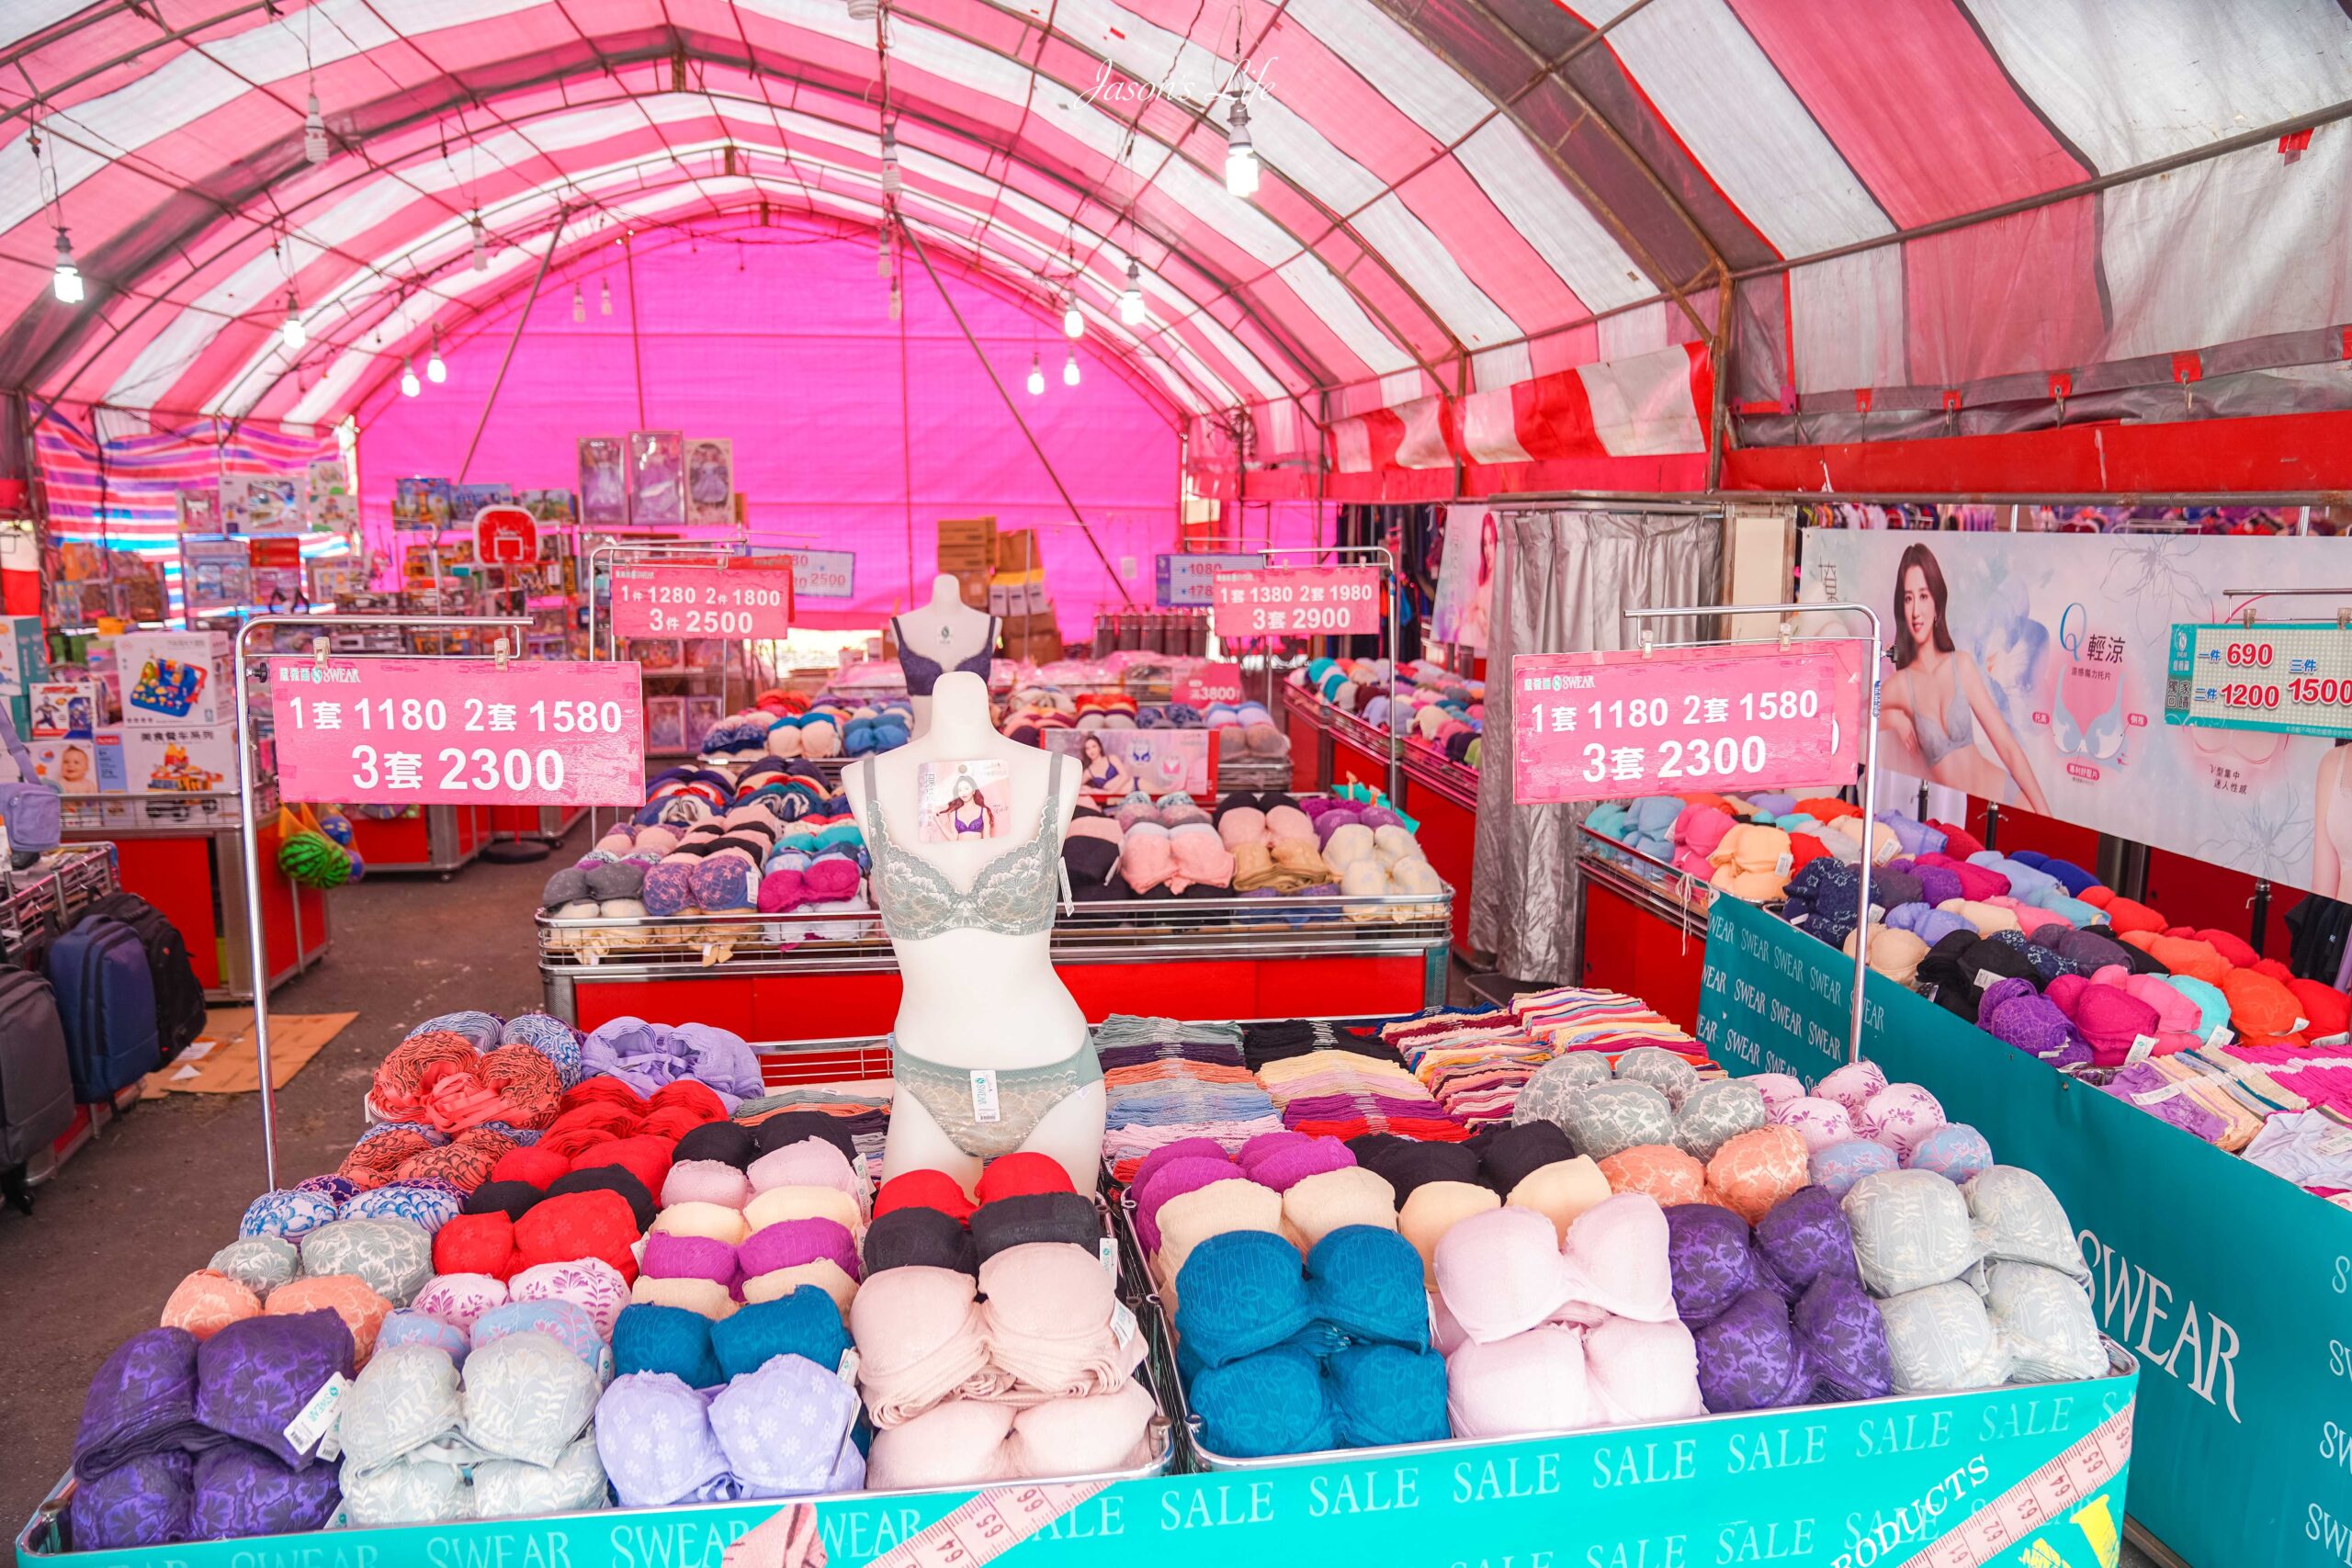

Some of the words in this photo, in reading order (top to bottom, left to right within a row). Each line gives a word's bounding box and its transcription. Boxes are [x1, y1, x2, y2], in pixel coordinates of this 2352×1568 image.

[810, 573, 845, 586] 2500
[1250, 586, 1293, 604] 1380
[1329, 584, 1373, 602] 1980
[648, 586, 696, 604] 1280
[733, 589, 781, 607] 1800
[685, 611, 753, 634] 2500
[1293, 607, 1351, 629] 2900
[2086, 634, 2126, 664] 輕涼
[2199, 649, 2221, 662] 一件
[2225, 642, 2274, 667] 690
[323, 668, 361, 682] SWEAR
[2289, 659, 2317, 673] 三件
[1563, 674, 1595, 690] SWEAR
[2194, 688, 2218, 702] 二件
[2221, 682, 2280, 709] 1200
[2288, 678, 2352, 706] 1500
[354, 697, 447, 732] 1180
[528, 700, 623, 734] 1580
[1588, 698, 1668, 730] 1180
[1739, 690, 1818, 722] 1580
[437, 747, 566, 793] 2300
[1657, 735, 1766, 779] 2300
[1741, 927, 1770, 964] SWEAR
[1774, 946, 1804, 985] SWEAR
[1810, 966, 1841, 1007] SWEAR
[1734, 978, 1766, 1016] SWEAR
[1770, 998, 1802, 1039] SWEAR
[1808, 1021, 1842, 1064] SWEAR
[1725, 1029, 1760, 1068] SWEAR
[2076, 1229, 2242, 1424] SWEAR
[1032, 1496, 1125, 1541] ALE
[1160, 1482, 1274, 1530] SALE
[1308, 1468, 1420, 1517] SALE
[1453, 1453, 1561, 1504] SALE
[1593, 1439, 1697, 1489] SALE
[1727, 1426, 1827, 1474] SALE
[1856, 1411, 1952, 1458] SALE
[1978, 1397, 2074, 1441] SALE
[2050, 1473, 2071, 1498] 64
[2083, 1450, 2104, 1474] 65
[976, 1513, 1005, 1539] 65
[1716, 1518, 1816, 1565] SALE
